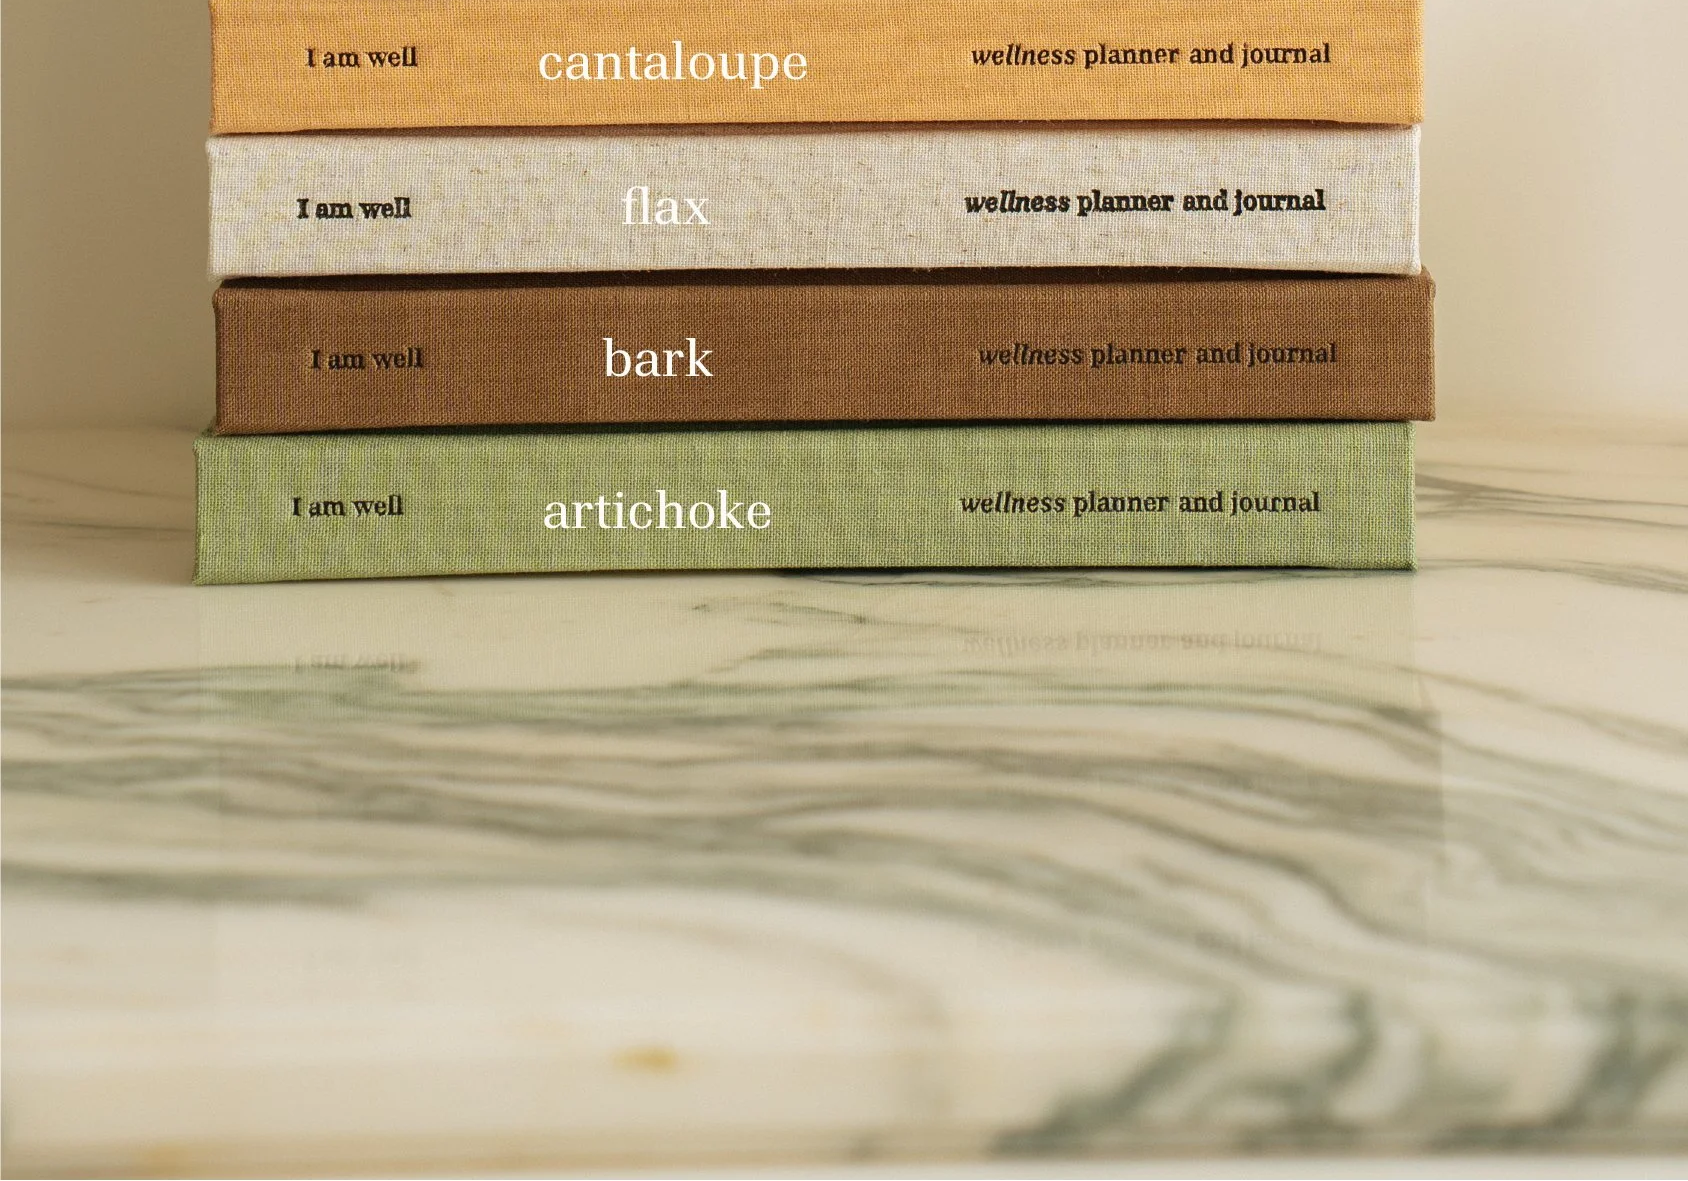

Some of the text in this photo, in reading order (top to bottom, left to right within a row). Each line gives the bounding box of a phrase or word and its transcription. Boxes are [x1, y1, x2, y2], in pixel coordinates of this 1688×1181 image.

[306, 46, 417, 67] I am well
[972, 43, 1330, 69] wellness planner and journal
[297, 197, 411, 219] I am well
[965, 189, 1326, 217] wellness planner and journal
[312, 348, 424, 370] I am well
[979, 342, 1337, 370] wellness planner and journal
[293, 494, 403, 517] I am well
[961, 490, 1319, 517] wellness planner and journal
